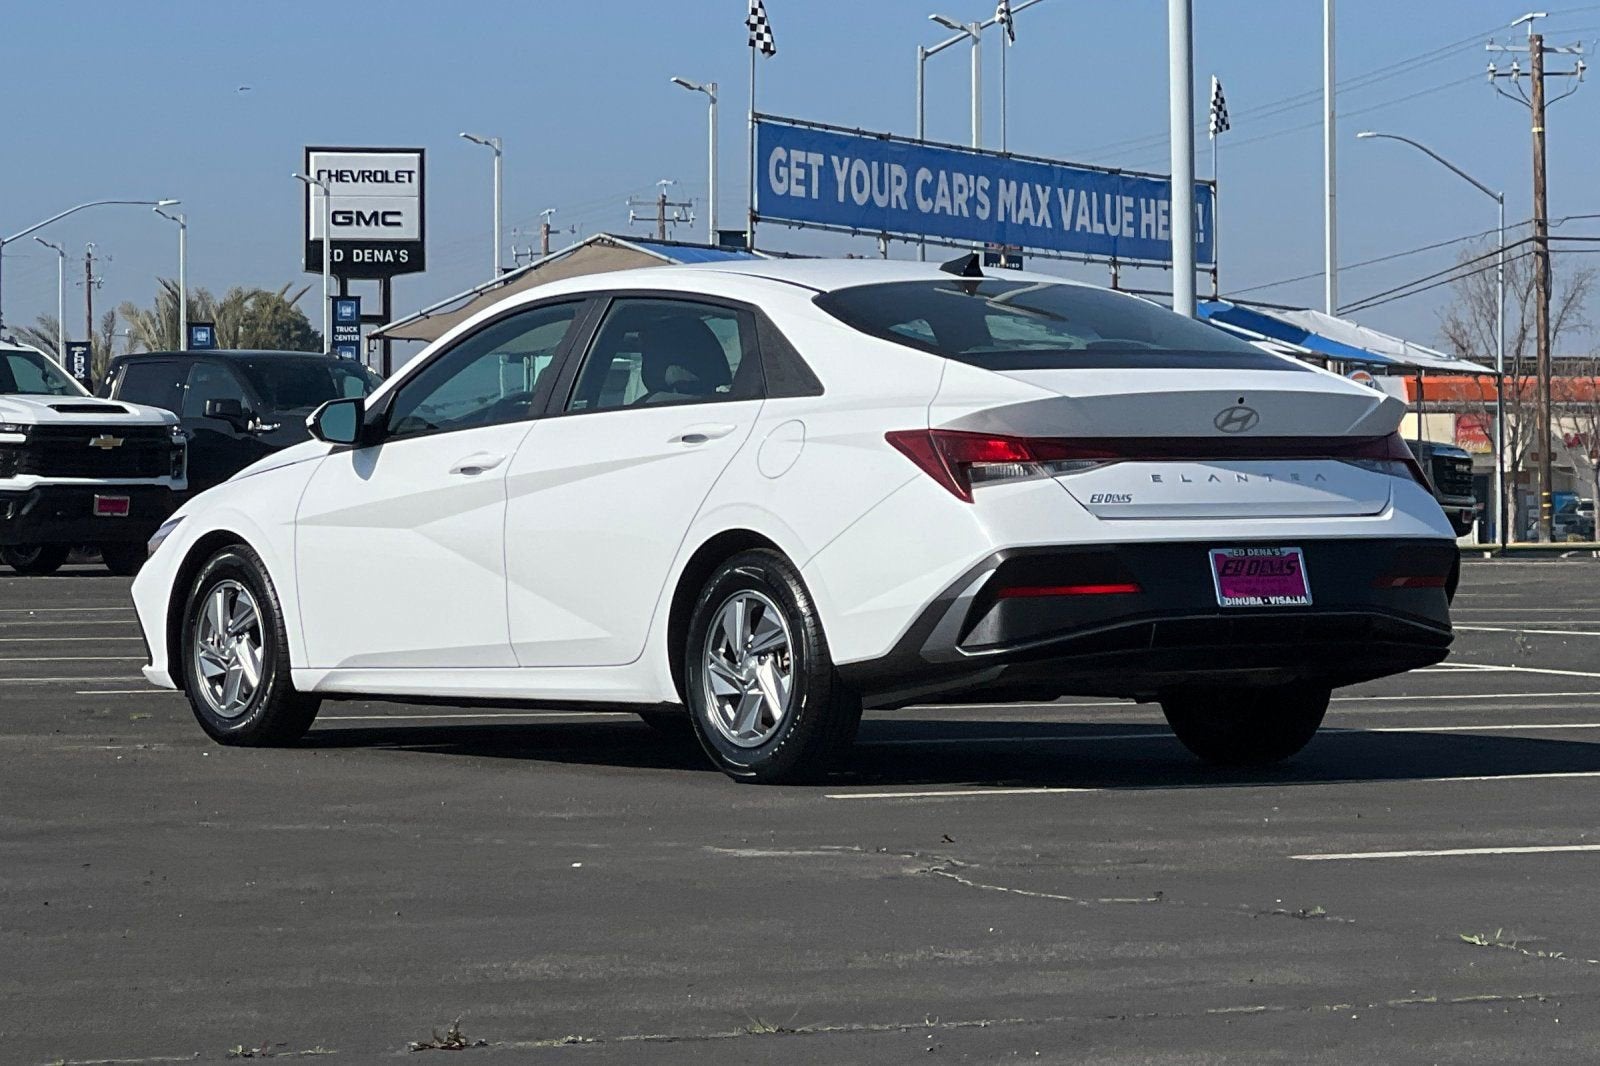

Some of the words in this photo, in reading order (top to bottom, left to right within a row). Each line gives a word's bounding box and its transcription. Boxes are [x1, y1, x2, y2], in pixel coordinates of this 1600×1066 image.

[316, 169, 416, 184] CHEVROLET
[768, 146, 824, 200] GET
[831, 154, 909, 211] YOUR
[914, 166, 991, 221] CAR'S
[997, 178, 1053, 229] MAX
[1056, 187, 1135, 239] VALUE
[1140, 197, 1205, 243] HE!
[331, 210, 404, 227] GMC
[352, 249, 409, 263] DENA'S
[333, 334, 360, 342] CENTER
[1150, 473, 1328, 484] ELANTRA
[1232, 548, 1246, 557] ED
[1225, 596, 1263, 606] DINUBA
[1268, 595, 1308, 605] VISALIA
